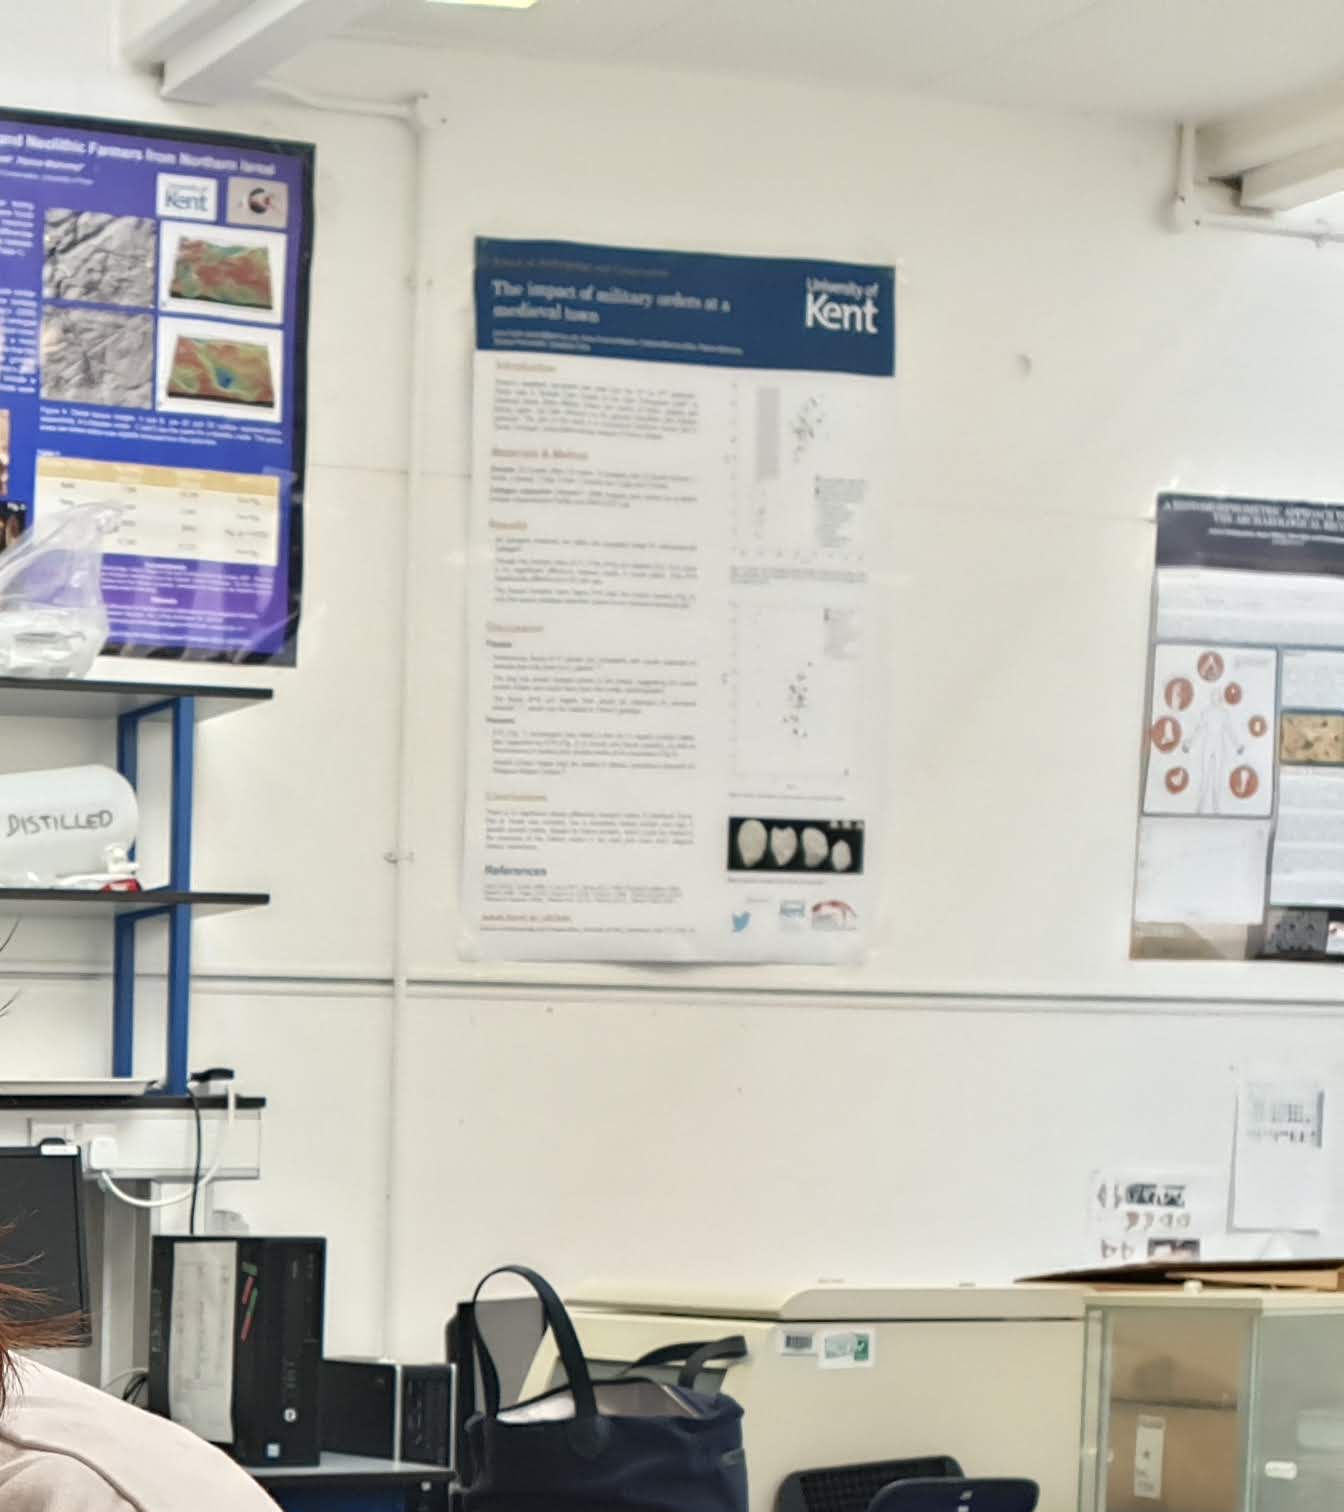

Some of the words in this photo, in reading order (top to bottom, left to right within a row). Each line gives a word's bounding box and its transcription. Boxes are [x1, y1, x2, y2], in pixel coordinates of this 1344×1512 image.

[164, 187, 208, 212] Kent
[805, 293, 879, 334] Kent
[6, 810, 113, 837] DISTILLED
